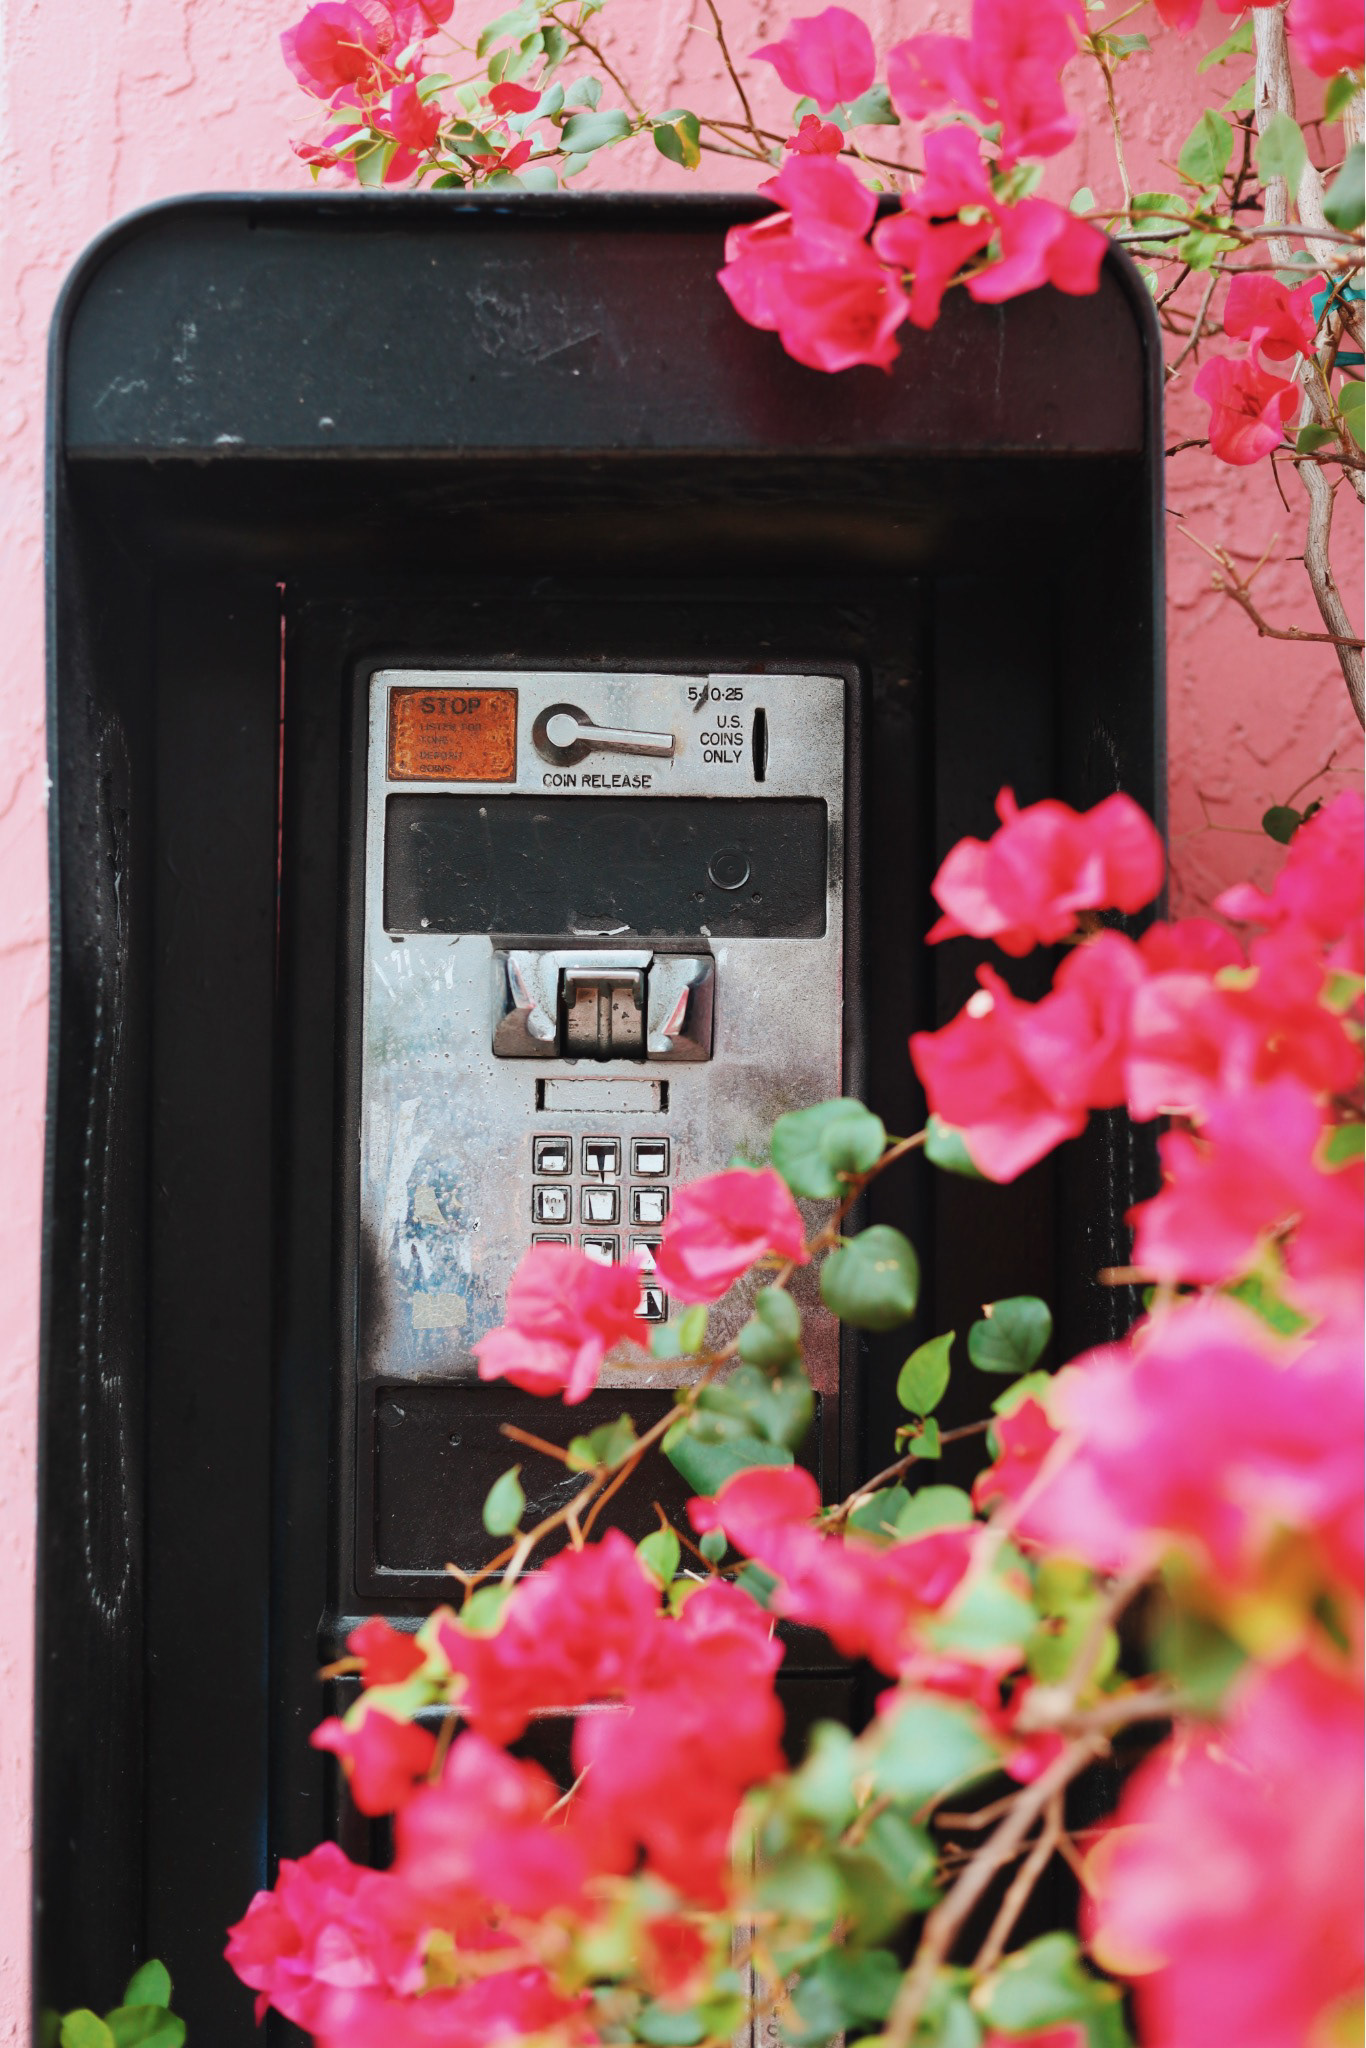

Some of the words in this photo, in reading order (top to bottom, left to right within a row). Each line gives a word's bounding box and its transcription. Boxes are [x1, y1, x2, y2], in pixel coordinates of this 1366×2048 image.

[421, 697, 481, 715] STOP
[717, 715, 743, 728] U.S.
[700, 732, 743, 746] COINS
[703, 750, 742, 763] ONLY
[543, 774, 576, 787] COIN
[581, 775, 652, 788] RELEASE
